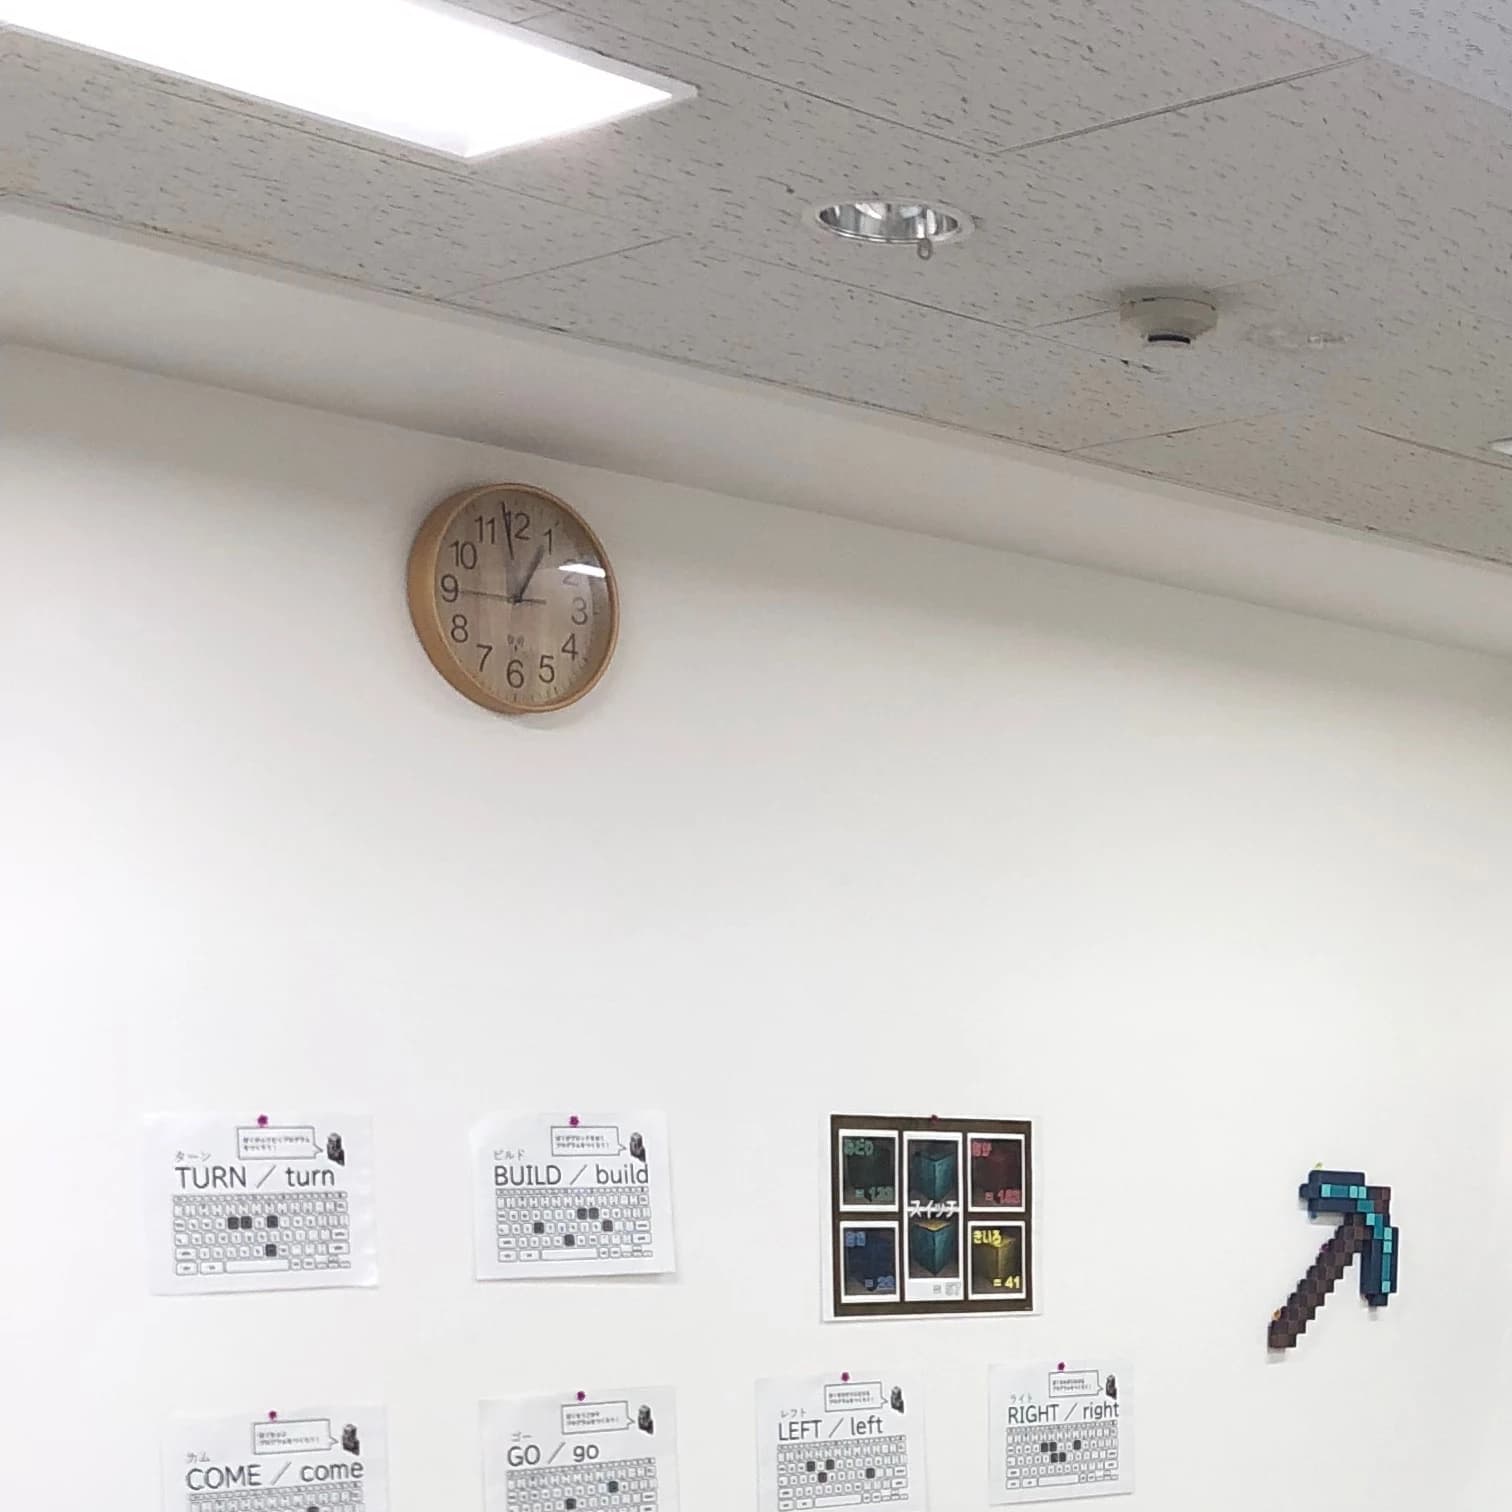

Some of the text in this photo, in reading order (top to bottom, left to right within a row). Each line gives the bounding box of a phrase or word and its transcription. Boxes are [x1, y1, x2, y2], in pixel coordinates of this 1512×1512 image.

[474, 516, 496, 544] 11
[543, 528, 553, 554] 1
[449, 540, 478, 570] 10
[440, 574, 458, 603] 9
[572, 596, 588, 626] 3
[451, 614, 468, 643] 8
[476, 643, 492, 672] 7
[560, 632, 578, 660] 4
[507, 659, 524, 689] 6
[538, 654, 555, 684] 5
[175, 1165, 247, 1189] TURN
[286, 1167, 336, 1187] turn
[494, 1164, 562, 1186] BUILD
[596, 1163, 649, 1185] build
[973, 1230, 1003, 1247] きいろ
[1005, 1276, 1020, 1289] 41
[1008, 1404, 1060, 1424] RIGHT
[1083, 1401, 1119, 1420] right
[778, 1419, 822, 1441] LEFT
[850, 1415, 884, 1436] left
[507, 1444, 541, 1467] GO
[573, 1444, 600, 1463] go
[185, 1464, 262, 1491] COME
[300, 1460, 365, 1482] come
